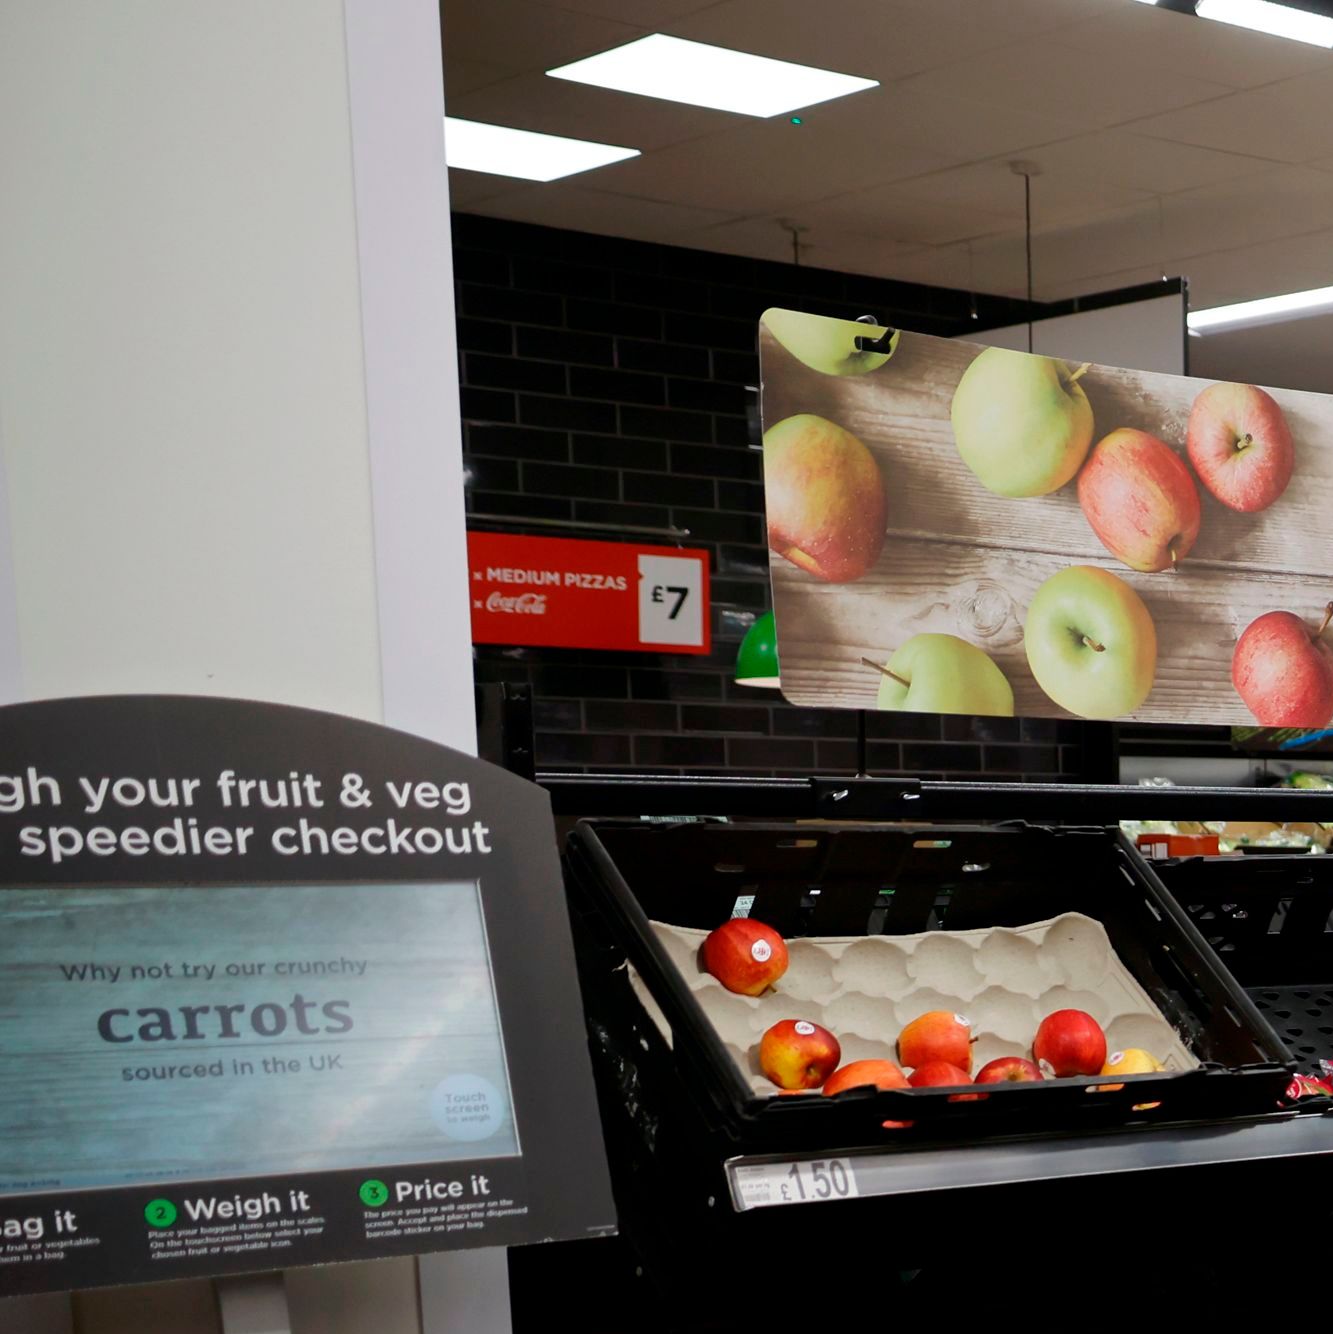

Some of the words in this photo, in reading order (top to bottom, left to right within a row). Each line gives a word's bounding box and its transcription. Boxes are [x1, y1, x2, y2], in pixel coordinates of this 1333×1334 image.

[487, 567, 560, 586] MEDIUM
[564, 575, 627, 591] PIZZAS
[652, 586, 689, 620] £7
[79, 776, 202, 814] your
[217, 770, 325, 808] fruit
[340, 773, 373, 808] &
[386, 780, 472, 815] veg
[19, 818, 254, 862] speedier
[271, 819, 492, 855] checkout
[60, 963, 121, 983] Why
[130, 961, 173, 980] not
[181, 961, 216, 980] try
[225, 961, 266, 977] our
[274, 956, 368, 978] crunchy
[98, 994, 355, 1044] carrots
[121, 1059, 224, 1082] sourced
[232, 1057, 254, 1076] in
[262, 1055, 301, 1074] the
[309, 1054, 344, 1072] UK
[445, 1092, 486, 1103] Touch
[445, 1103, 489, 1113] screen
[396, 1178, 463, 1202] Price
[471, 1175, 490, 1196] it
[781, 1160, 849, 1201] £1.50
[184, 1192, 282, 1221] Weigh
[289, 1190, 310, 1212] it
[381, 1209, 403, 1218] price
[405, 1207, 421, 1216] you
[423, 1205, 438, 1214] pay
[457, 1202, 485, 1211] appear
[398, 1217, 427, 1226] Accept
[429, 1214, 445, 1222] and
[447, 1213, 469, 1222] place
[486, 1206, 528, 1217] dispensed
[0, 1218, 44, 1240] ag
[55, 1210, 78, 1233] it
[167, 1239, 183, 1247] the
[185, 1235, 242, 1246] touchscreen
[244, 1232, 272, 1241] below
[274, 1229, 301, 1237] select
[303, 1227, 323, 1236] your
[177, 1229, 198, 1238] your
[200, 1224, 236, 1234] bagged
[280, 1219, 294, 1227] the
[366, 1229, 402, 1239] barcode
[404, 1226, 431, 1235] sticker
[45, 1238, 100, 1248] vegetables
[151, 1250, 186, 1259] chosen
[222, 1242, 268, 1253] vegetable
